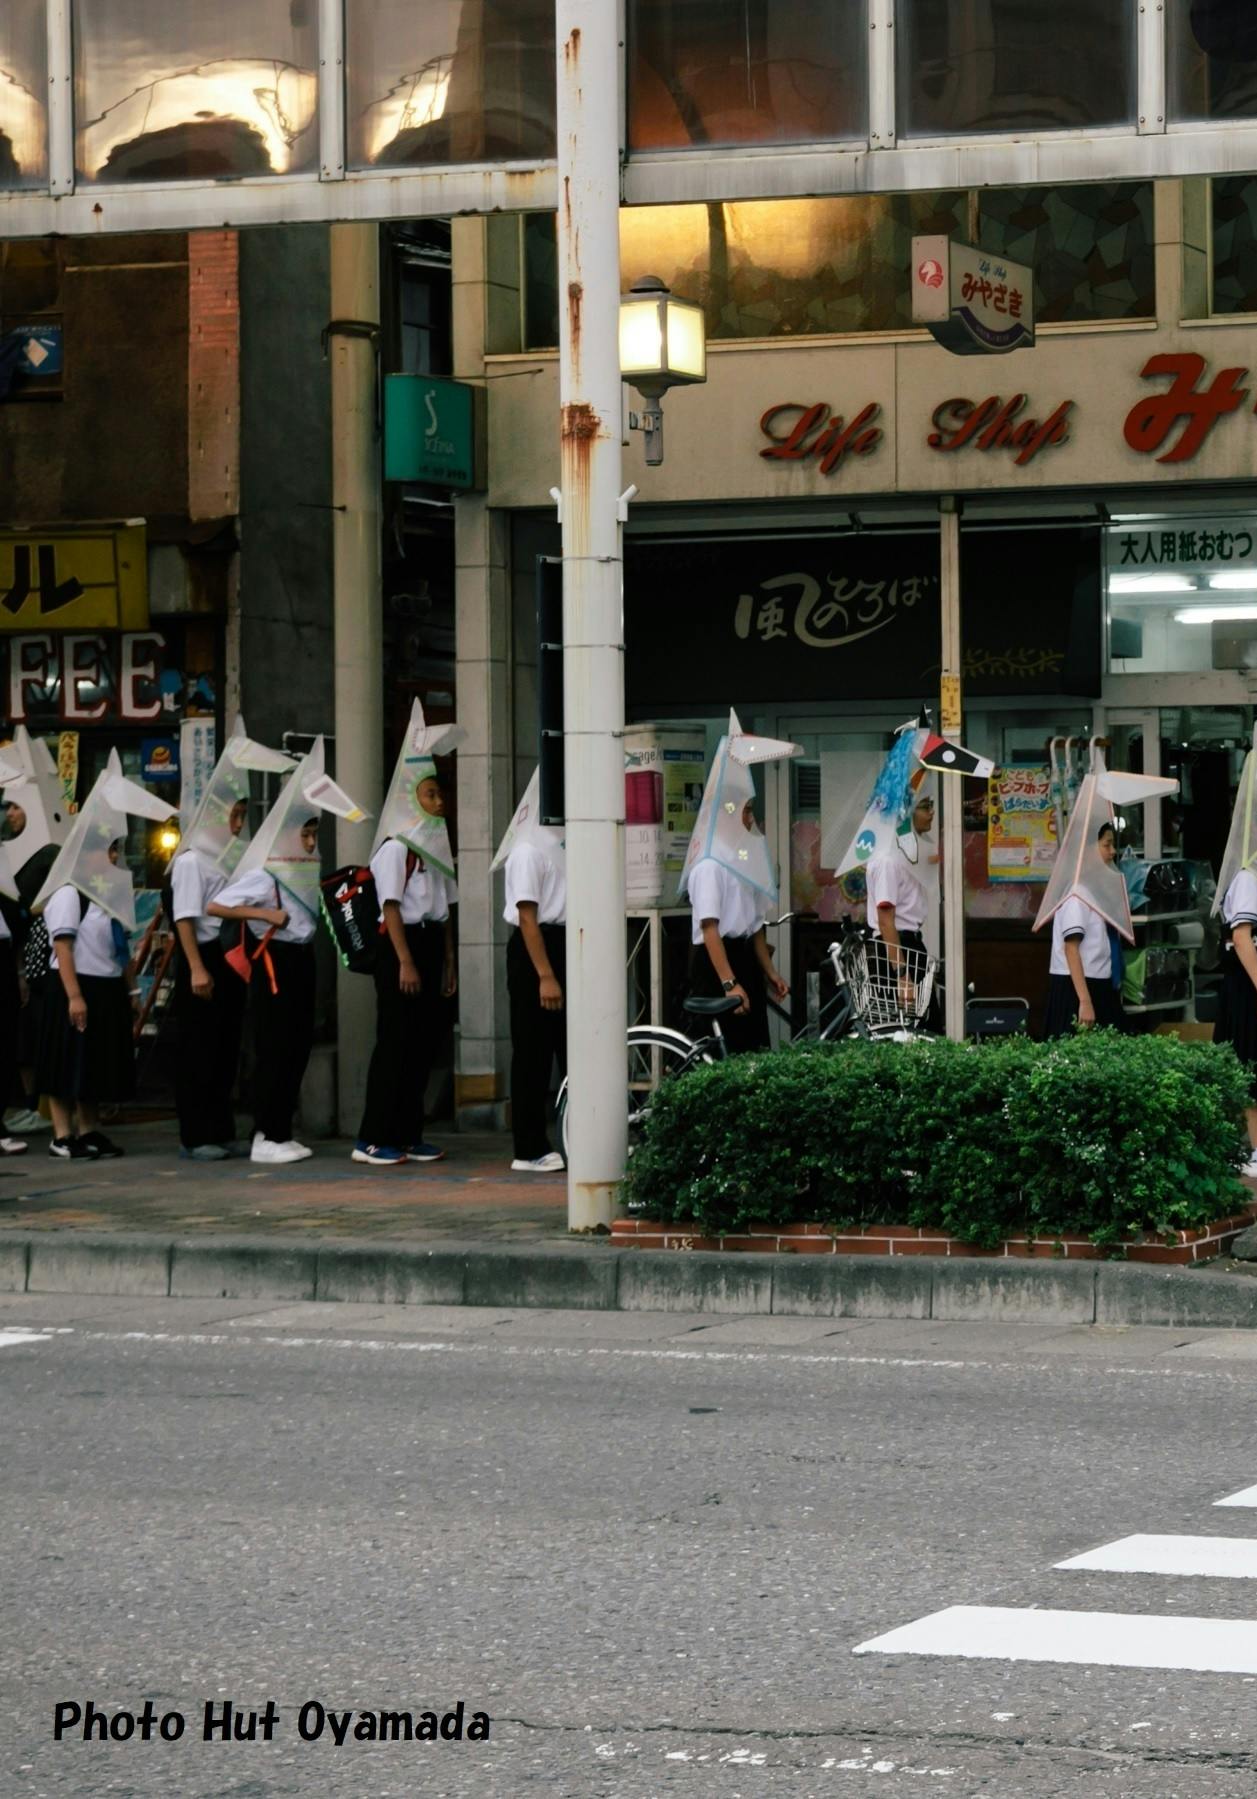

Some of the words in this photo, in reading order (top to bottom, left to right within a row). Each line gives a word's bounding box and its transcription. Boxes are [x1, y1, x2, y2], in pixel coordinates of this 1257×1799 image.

[962, 272, 1023, 319] みやざき
[760, 402, 882, 475] Life
[927, 393, 1074, 465] Shop
[1120, 528, 1253, 564] 大人用紙おむつ
[734, 570, 938, 648] 風のひろば
[9, 632, 167, 719] FEE
